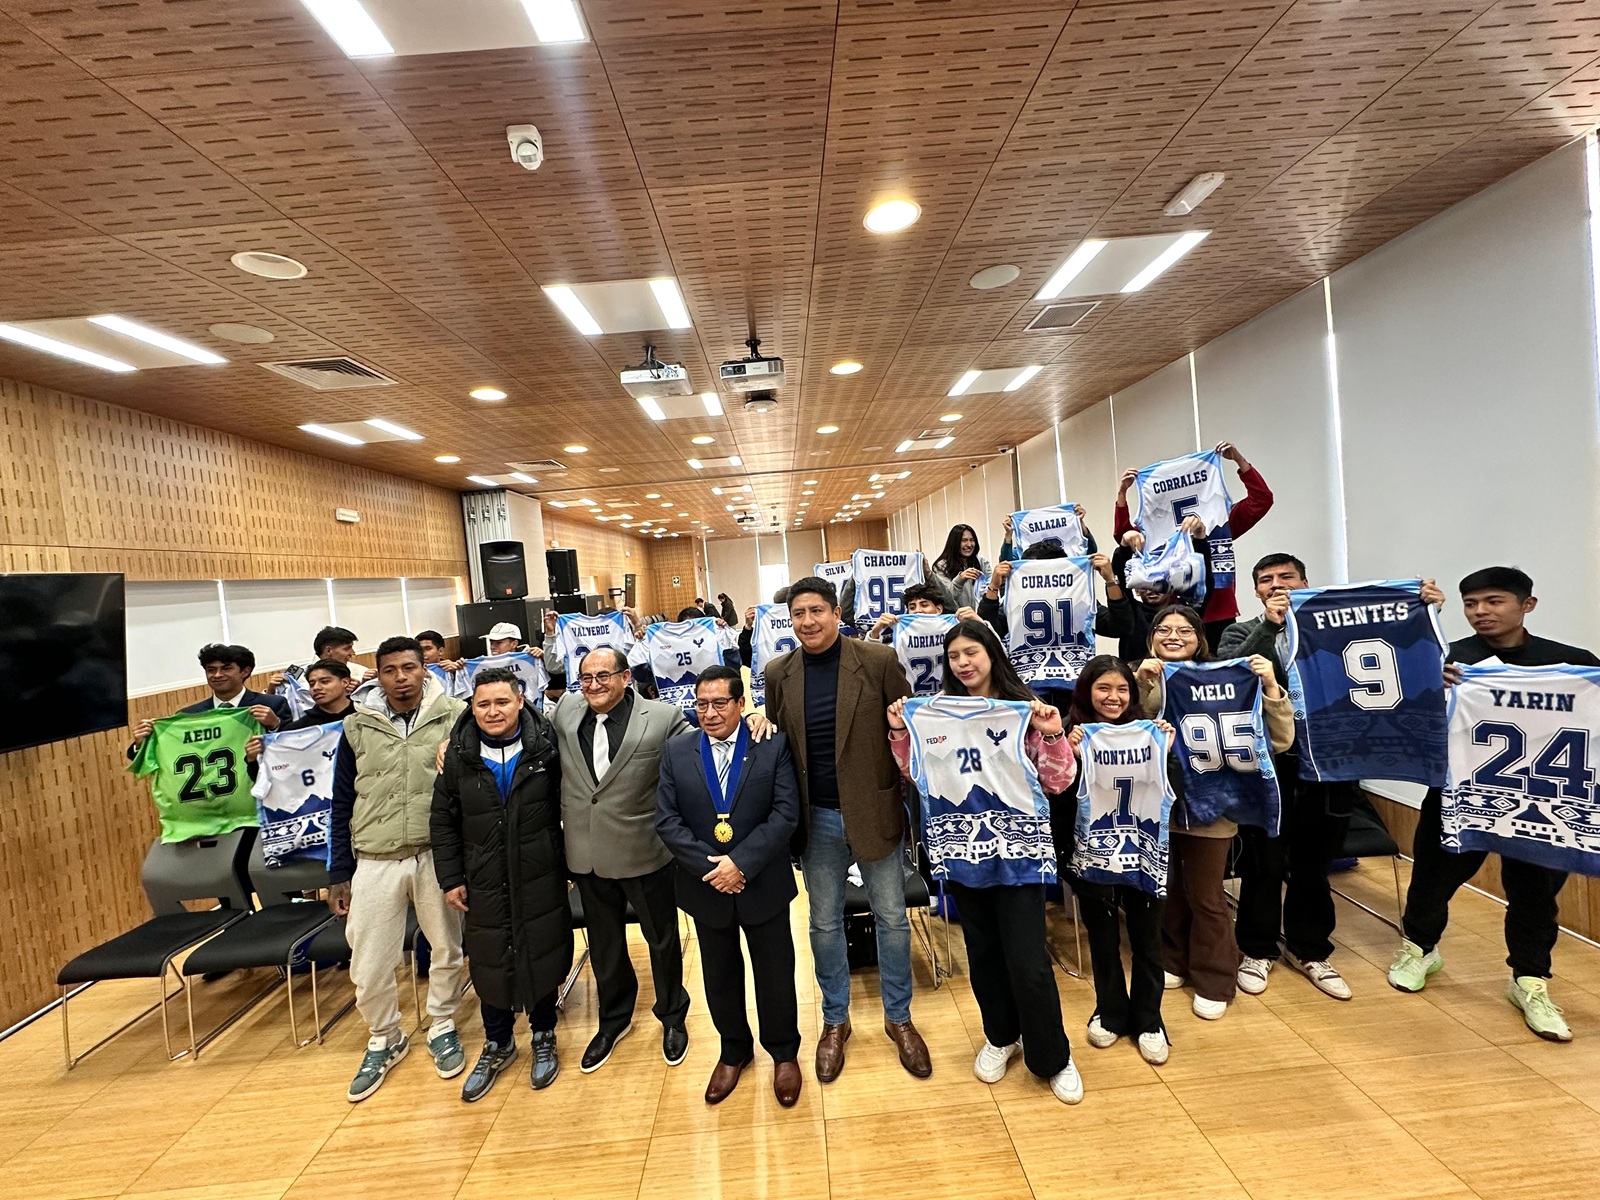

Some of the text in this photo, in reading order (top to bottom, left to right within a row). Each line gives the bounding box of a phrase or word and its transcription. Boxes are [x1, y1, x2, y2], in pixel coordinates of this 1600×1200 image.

[1153, 469, 1208, 494] CORRALES
[1171, 494, 1202, 528] 5
[1028, 517, 1067, 533] SALAZAR
[825, 566, 846, 576] SILVA
[864, 555, 907, 567] CHACON
[1021, 573, 1073, 589] CURASCO
[867, 575, 907, 619] 95
[1022, 598, 1077, 648] 91
[1313, 602, 1409, 630] FUENTES
[571, 624, 610, 637] VALVERDE
[676, 652, 692, 666] 25
[1342, 638, 1403, 711] 9
[1190, 683, 1236, 701] MELO
[1490, 689, 1576, 712] YARIN
[183, 726, 222, 744] AEDO
[1180, 710, 1260, 774] 95
[956, 747, 982, 775] 28
[1093, 745, 1152, 766] MONTALVO
[1470, 719, 1597, 804] 24
[173, 746, 239, 804] 23
[301, 769, 316, 787] 6
[1113, 776, 1137, 829] 1
